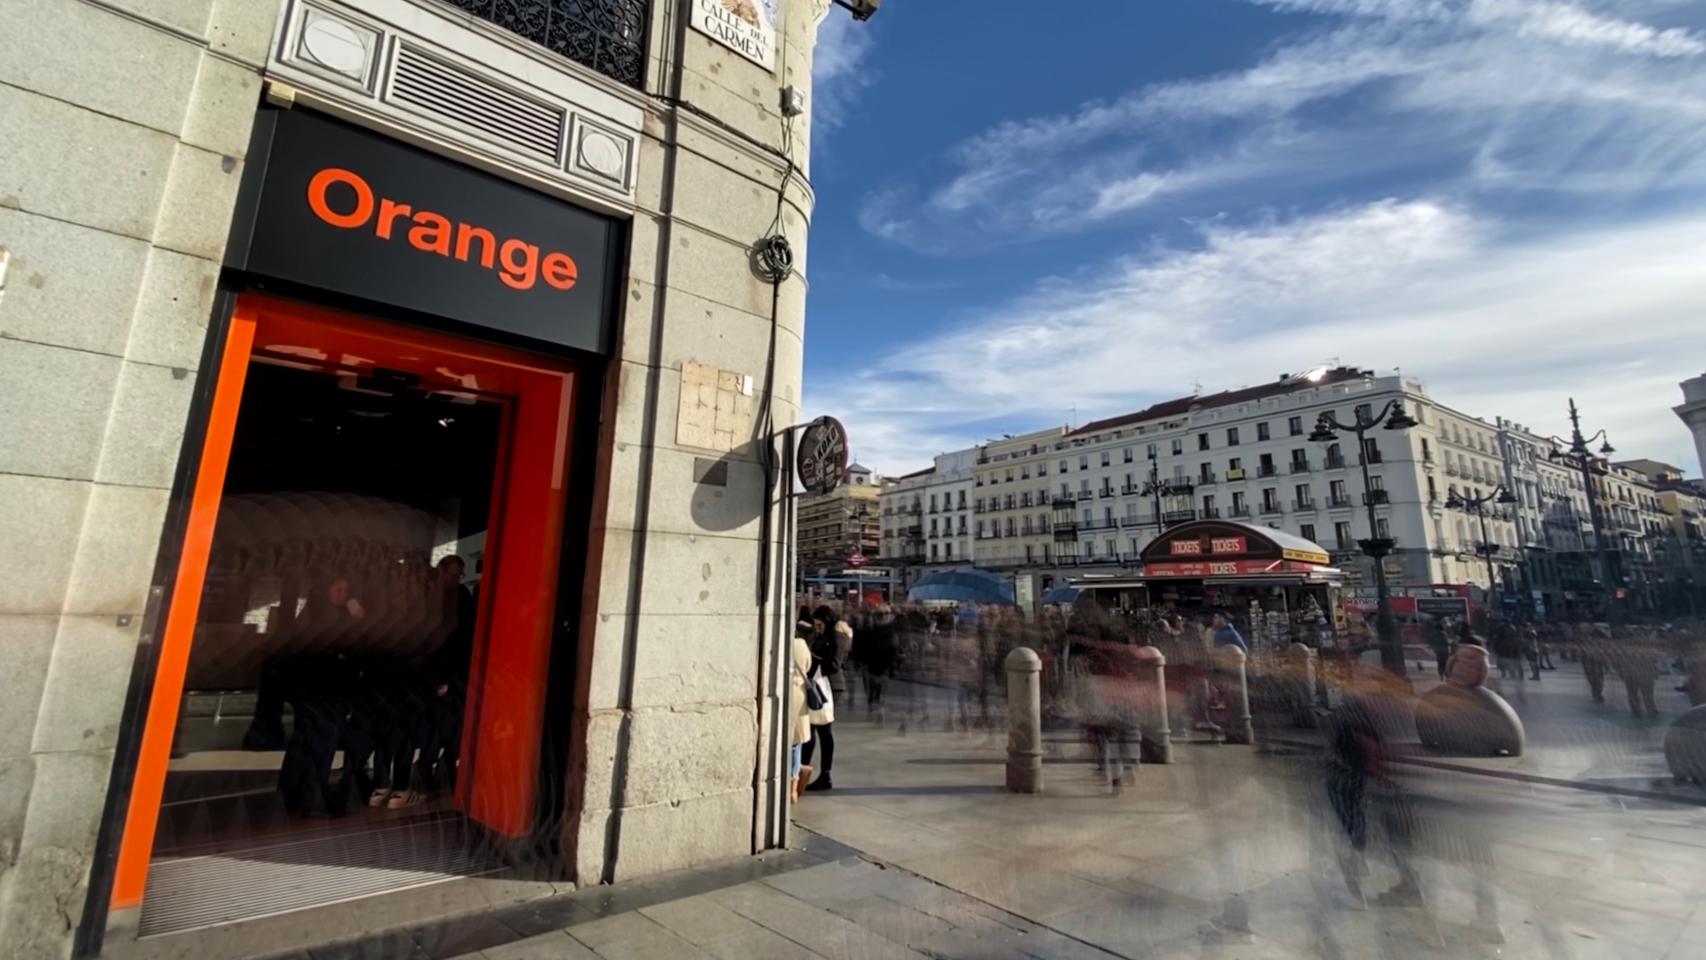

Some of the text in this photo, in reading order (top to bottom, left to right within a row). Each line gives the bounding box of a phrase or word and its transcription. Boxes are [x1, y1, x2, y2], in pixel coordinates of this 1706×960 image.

[701, 0, 768, 46] CALLE DEL
[704, 15, 764, 61] CARMEN
[307, 168, 578, 290] Orange
[1209, 562, 1237, 574] TICKETS
[1211, 538, 1240, 552] TICKETS
